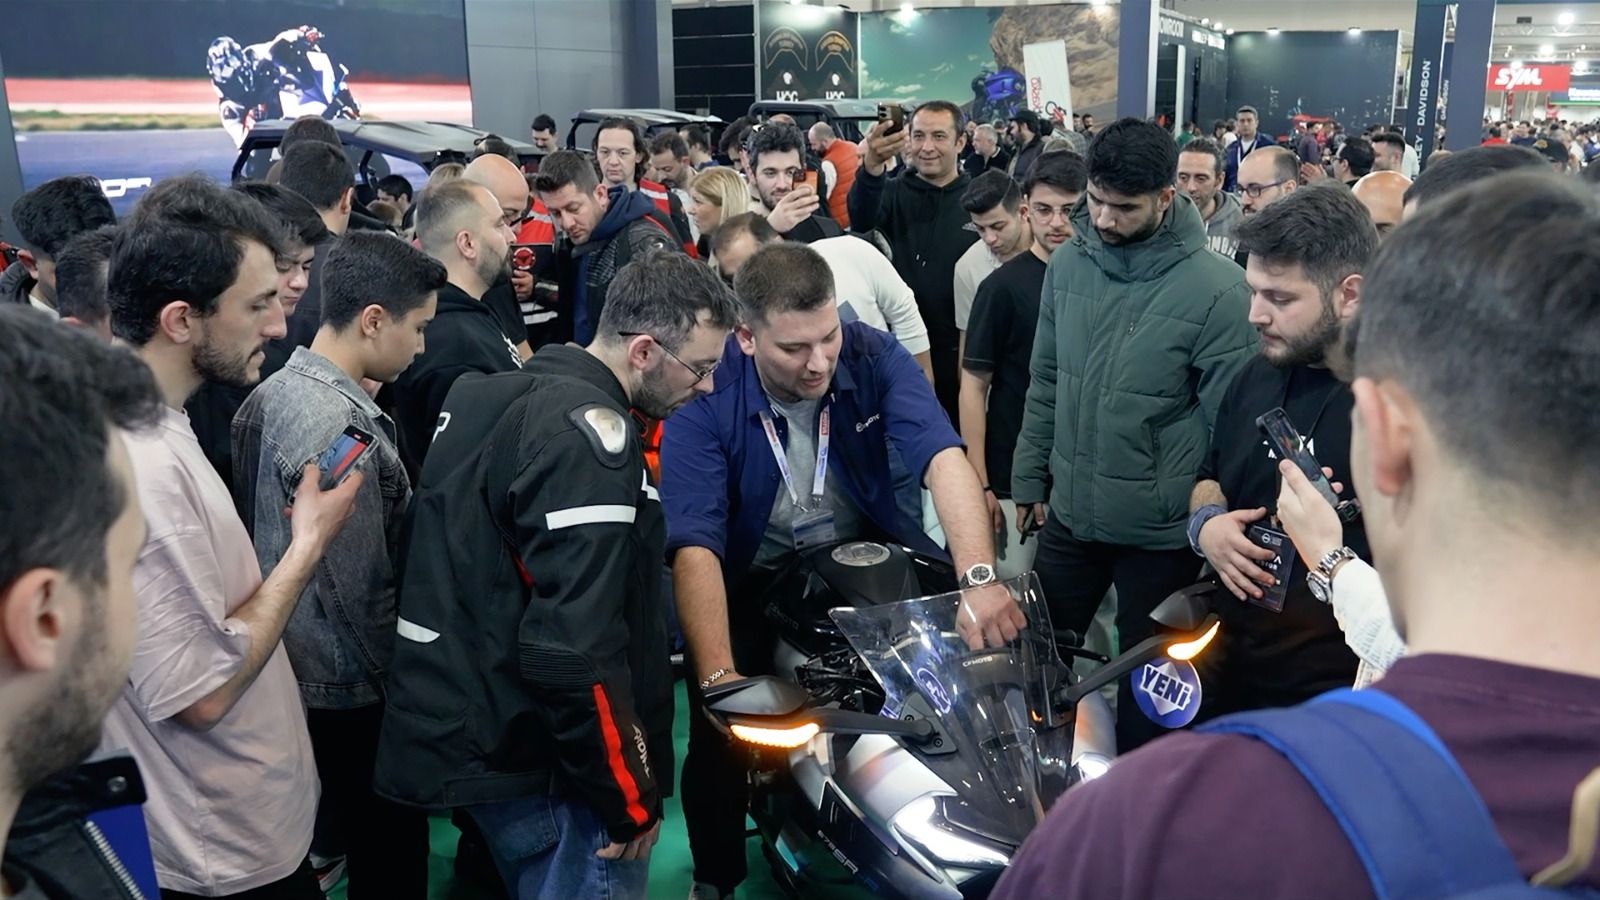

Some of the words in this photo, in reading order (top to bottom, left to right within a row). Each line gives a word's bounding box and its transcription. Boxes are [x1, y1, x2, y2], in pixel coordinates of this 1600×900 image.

[1159, 16, 1184, 38] OWROOM
[1494, 67, 1543, 89] SYM
[1416, 60, 1431, 126] DAVIDSON
